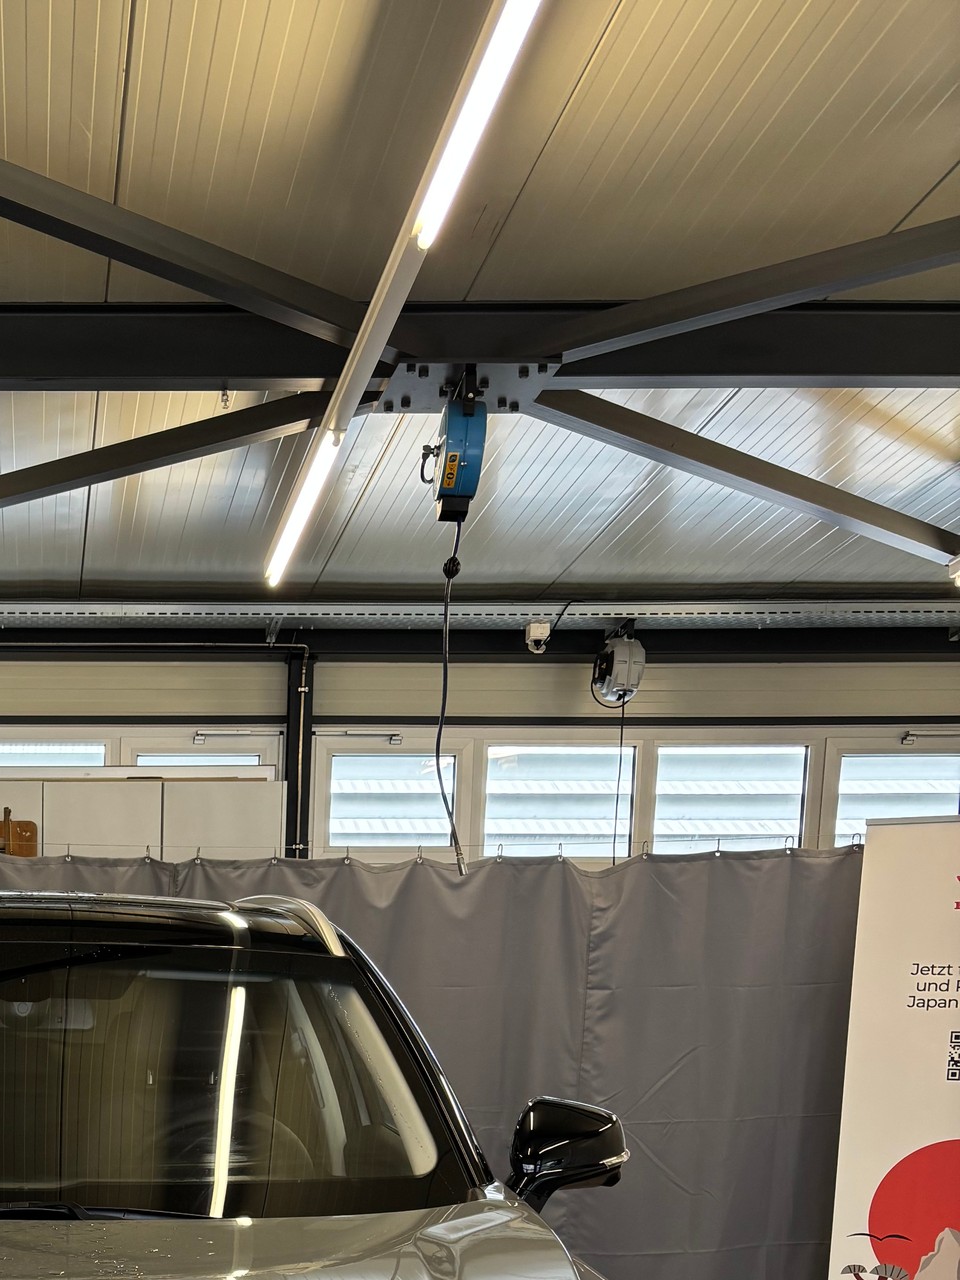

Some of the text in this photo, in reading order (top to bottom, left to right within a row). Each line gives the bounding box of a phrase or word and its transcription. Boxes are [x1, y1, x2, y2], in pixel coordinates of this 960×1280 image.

[910, 963, 953, 976] Jetzt
[916, 979, 950, 992] und
[906, 995, 959, 1011] Japan
